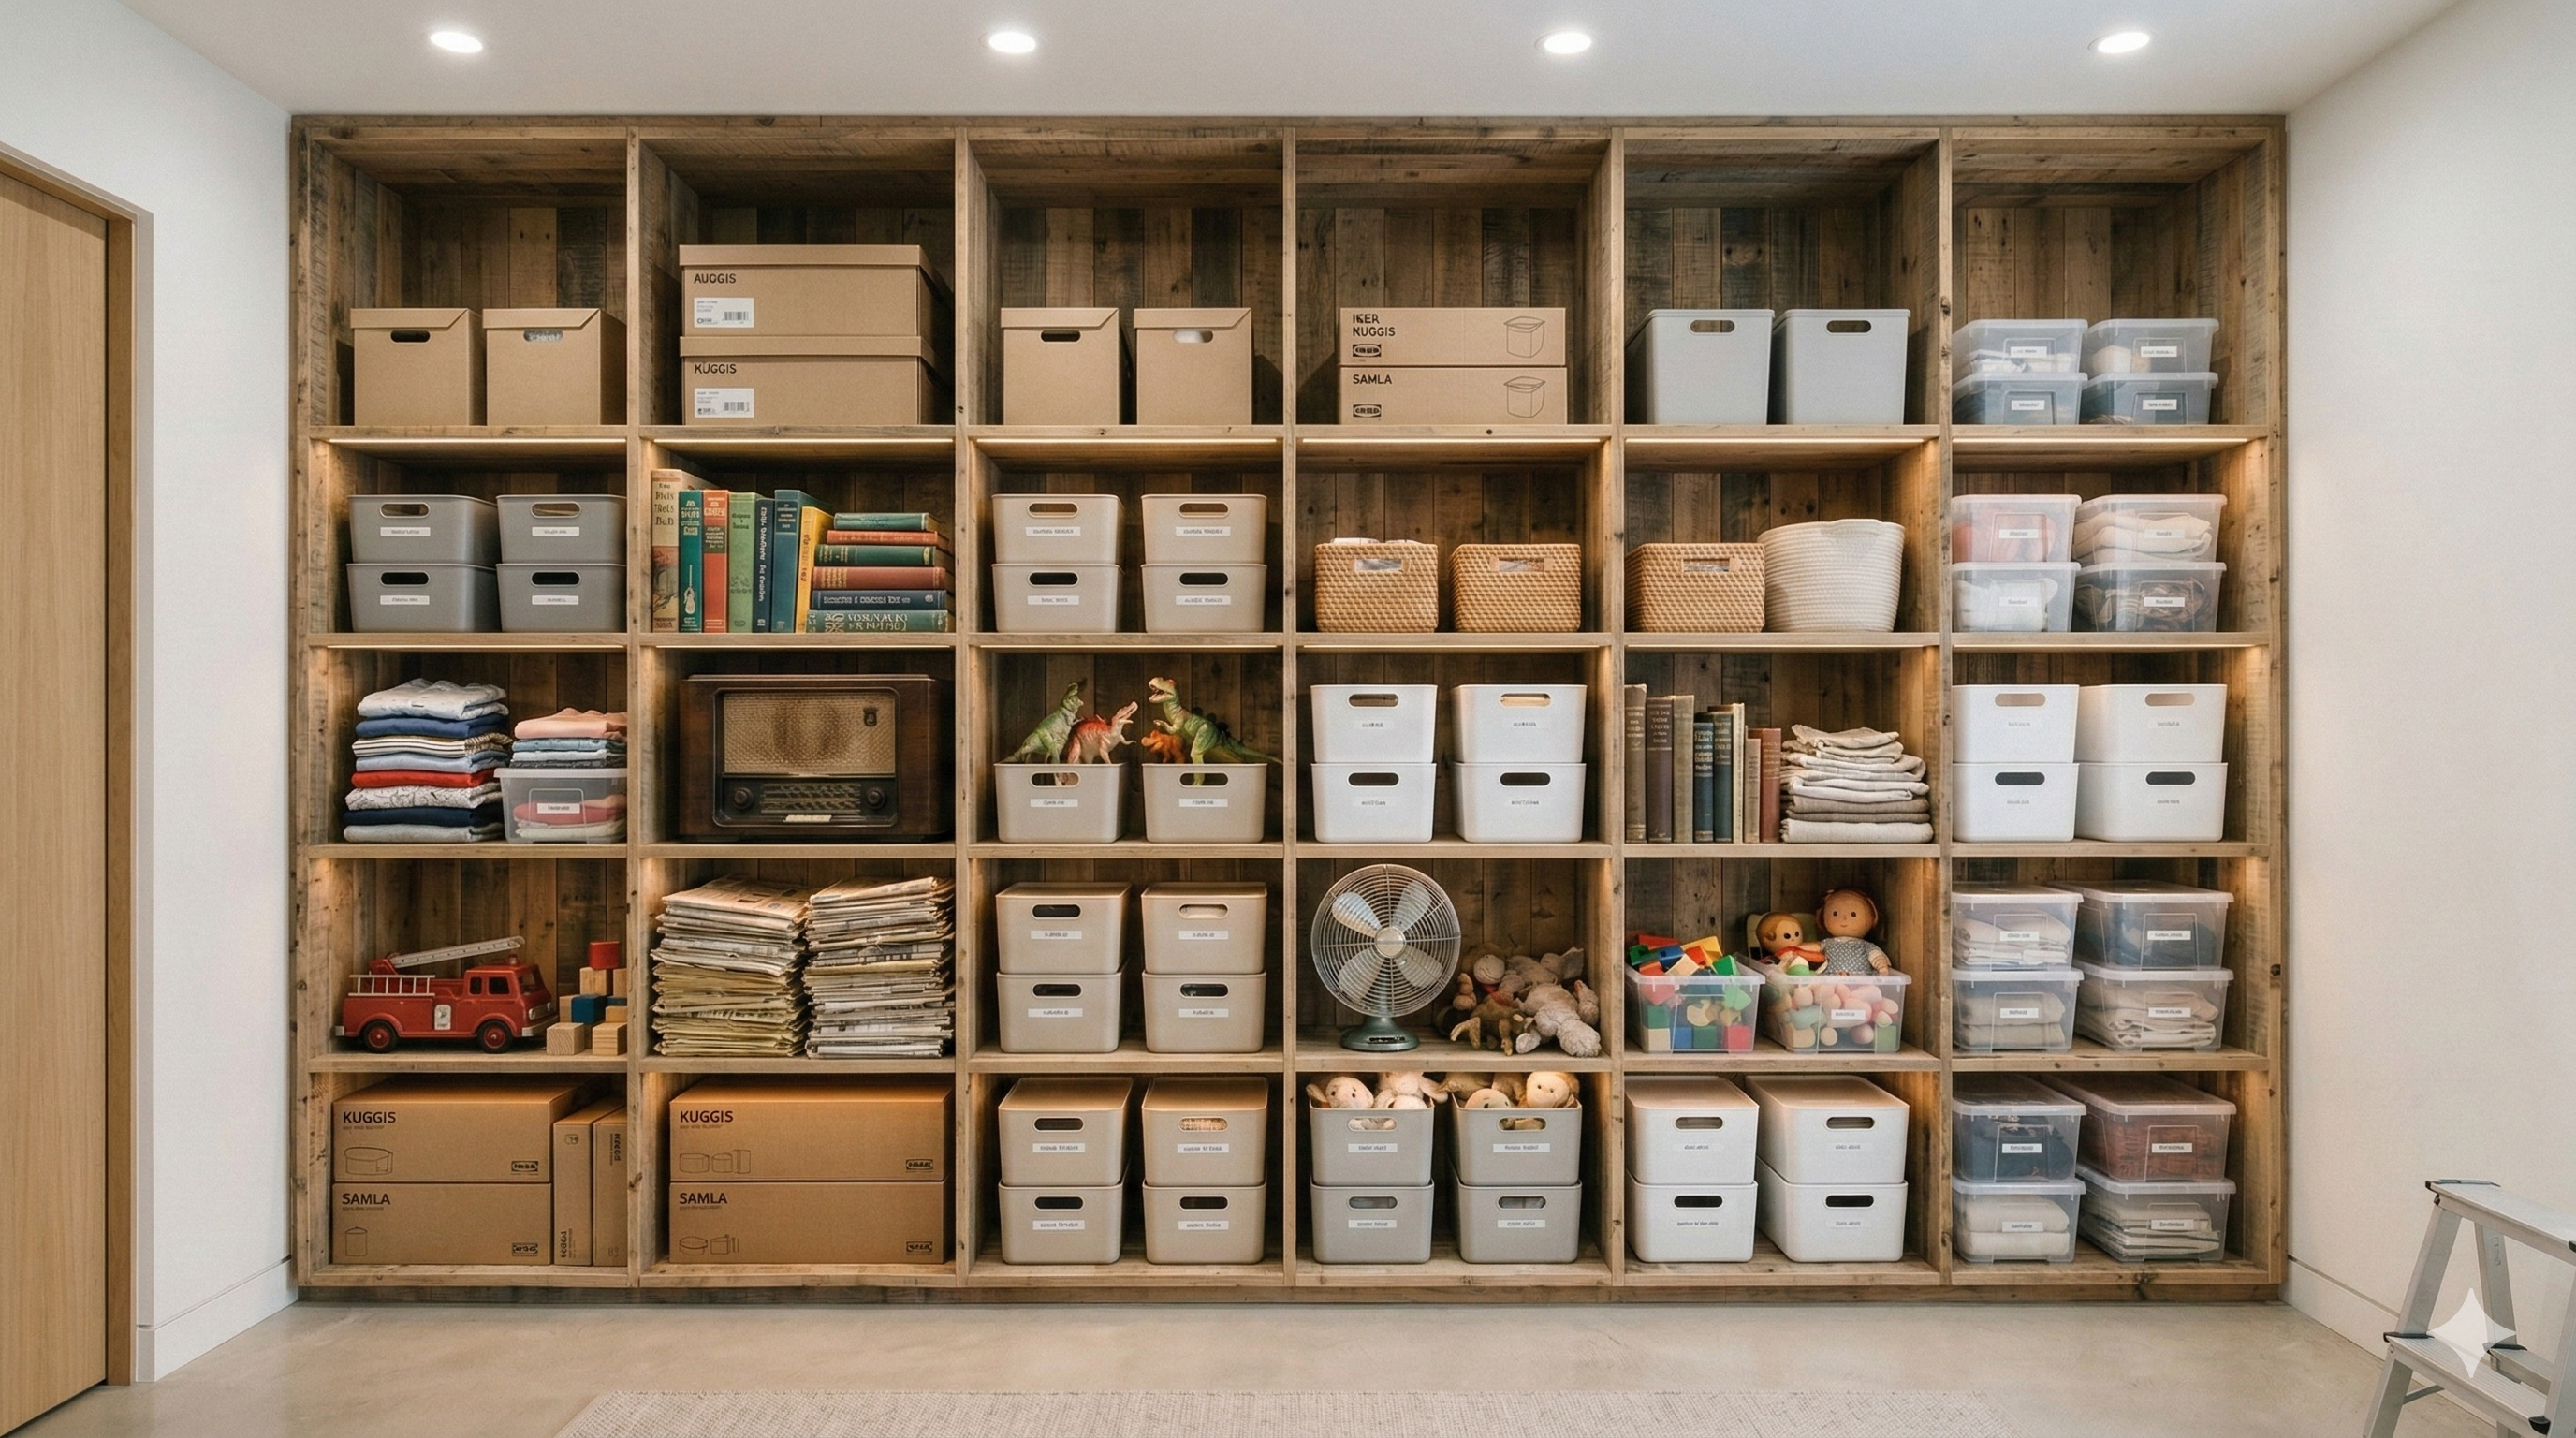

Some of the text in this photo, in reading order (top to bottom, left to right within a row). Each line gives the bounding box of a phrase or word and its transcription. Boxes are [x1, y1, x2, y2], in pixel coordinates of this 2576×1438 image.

[695, 363, 737, 374] KUGGIS
[1353, 374, 1393, 385] SAMLA
[343, 1111, 396, 1123] KUGGIS
[680, 1110, 734, 1123] KUGGIS
[342, 1193, 391, 1205] SAMLA
[679, 1192, 728, 1205] SAMLA
